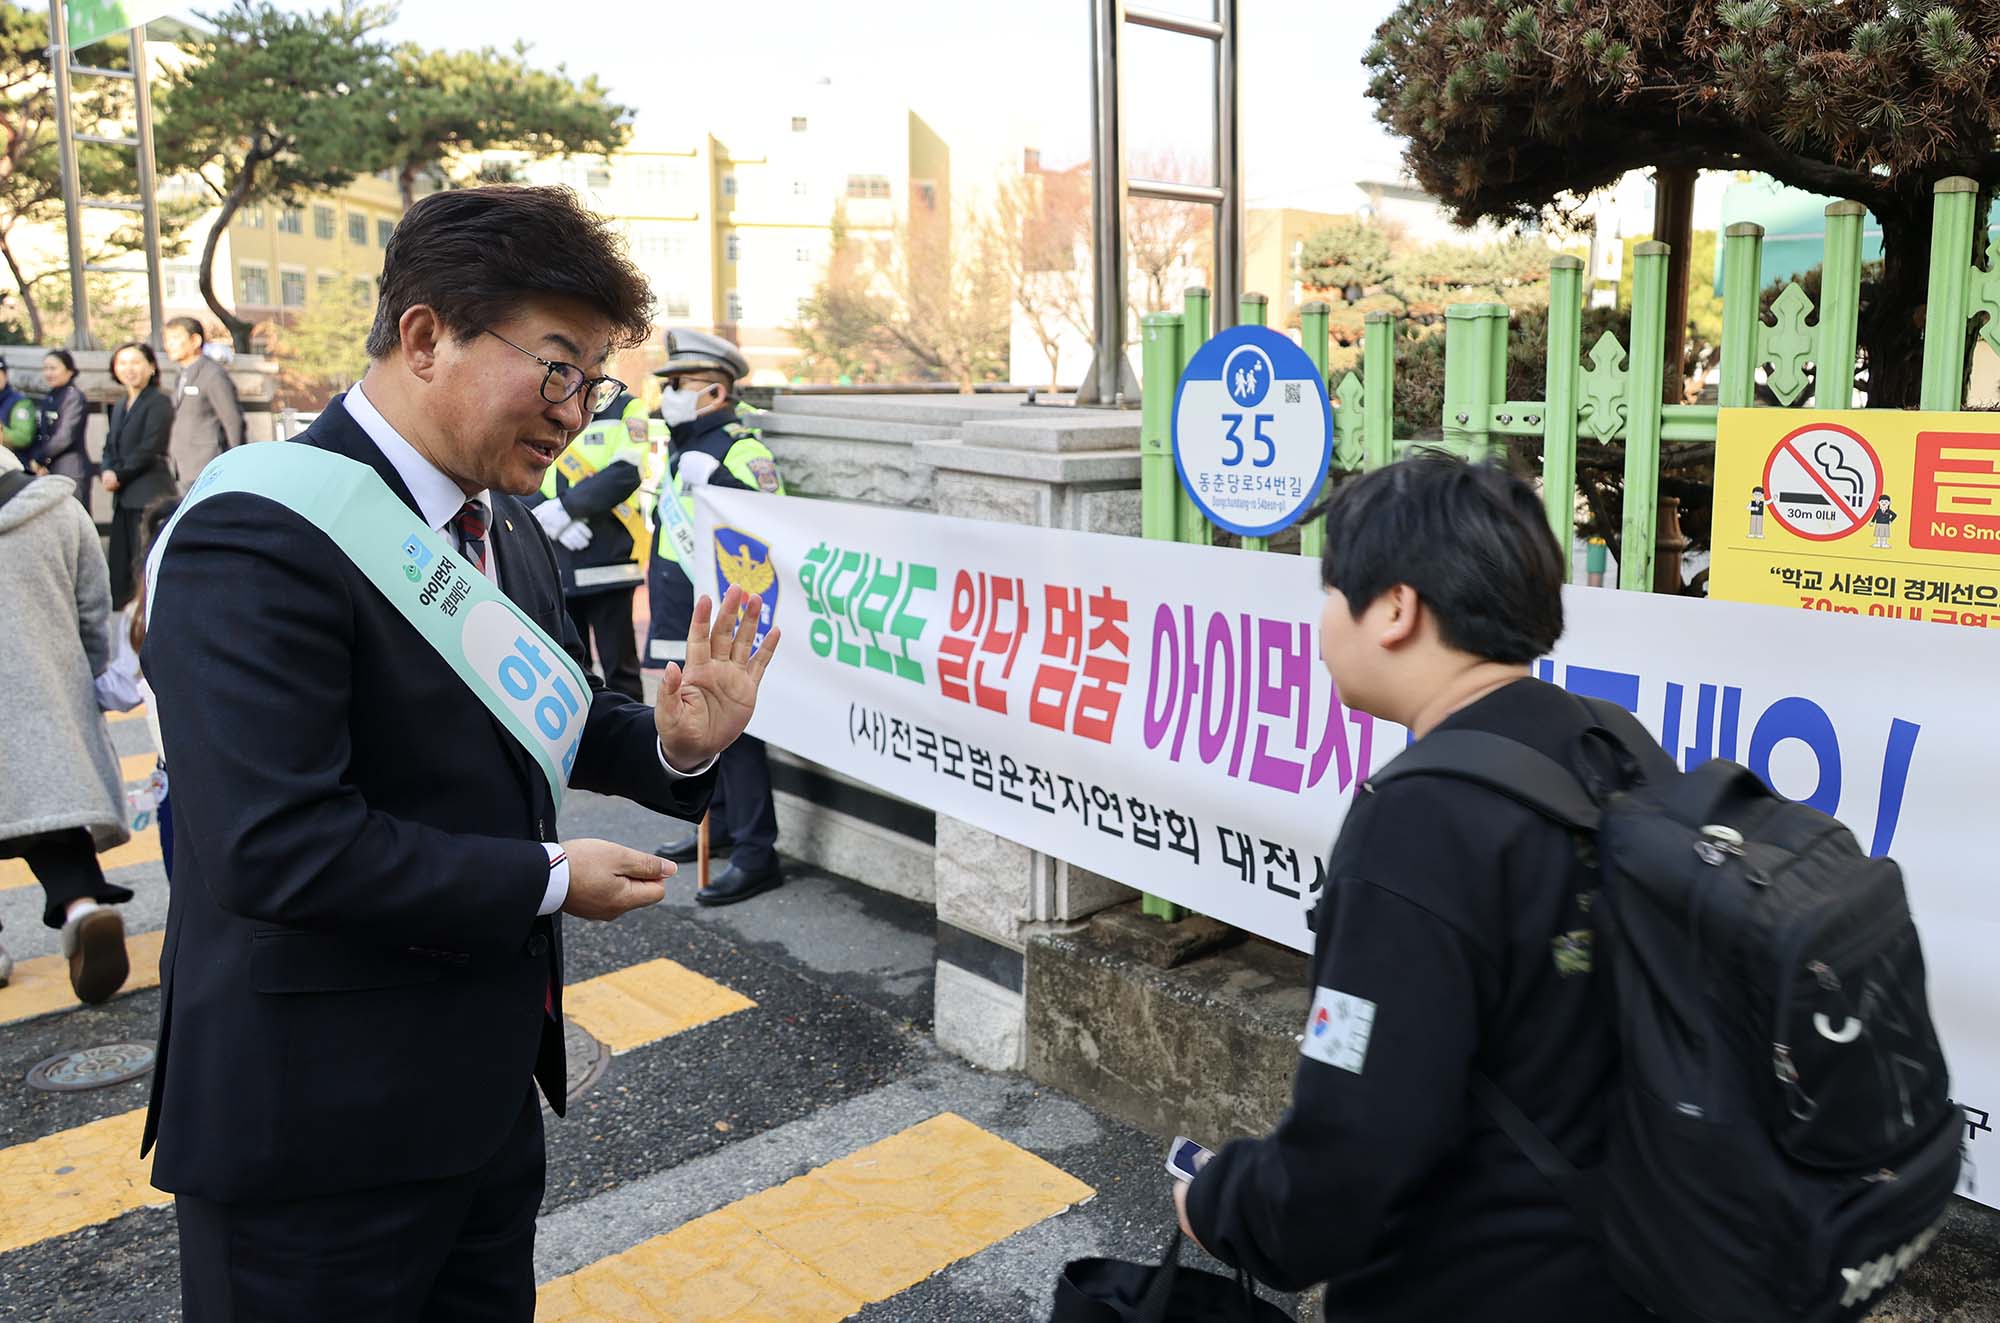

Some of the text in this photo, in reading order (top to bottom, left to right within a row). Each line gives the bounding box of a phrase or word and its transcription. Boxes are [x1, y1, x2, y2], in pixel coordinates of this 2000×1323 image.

[1221, 413, 1275, 467] 35
[1199, 472, 1302, 498] 동춘당로54번길
[1787, 508, 1836, 521] 30m 이내
[1930, 522, 1958, 538] No
[419, 556, 457, 606] 아이먼저
[440, 575, 471, 617] 캠페인
[1830, 574, 1896, 598] 시설의
[1904, 579, 2000, 608] 경계선으
[798, 541, 938, 685] 횡단보도
[937, 568, 1030, 716] 일단
[1029, 583, 1131, 744] 멈춤
[850, 702, 1326, 902] (사)전국모범운전자연합회 대전
